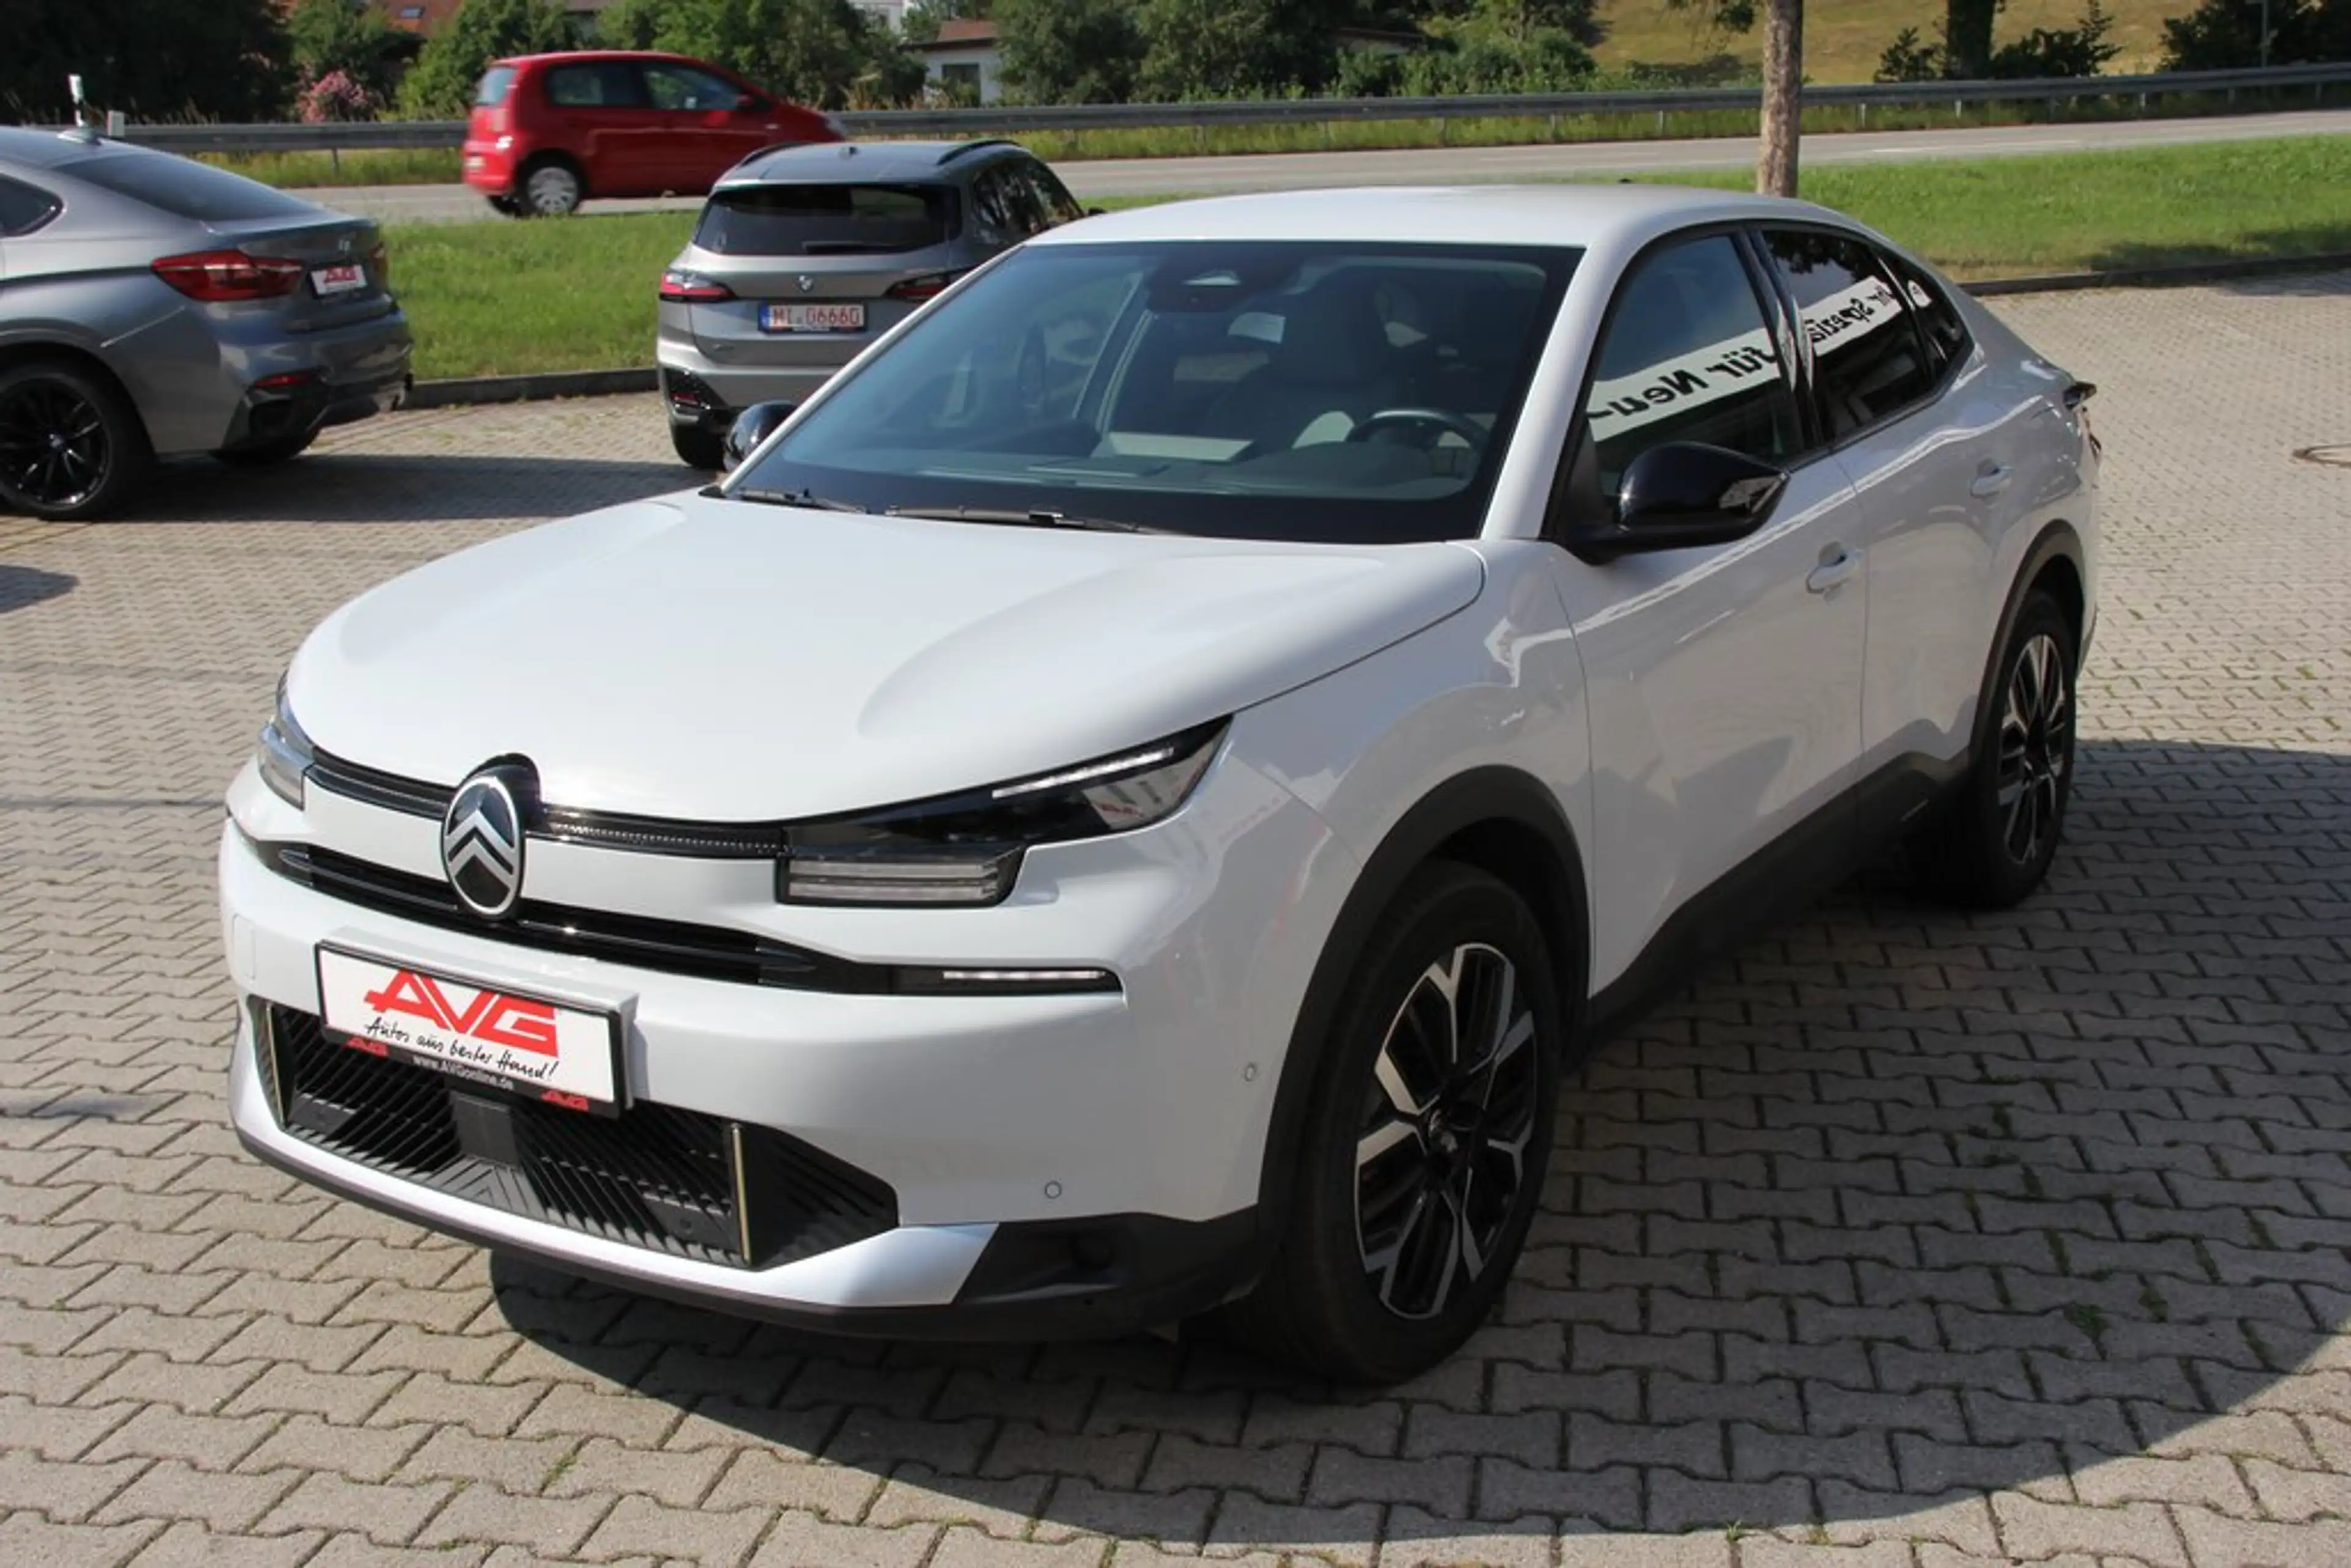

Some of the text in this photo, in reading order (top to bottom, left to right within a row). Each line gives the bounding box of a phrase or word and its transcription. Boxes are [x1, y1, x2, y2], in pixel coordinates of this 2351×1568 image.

[364, 969, 558, 1058] AVG
[364, 1016, 410, 1043] Autos
[416, 1034, 444, 1052] aus
[497, 1049, 560, 1081] Hand!
